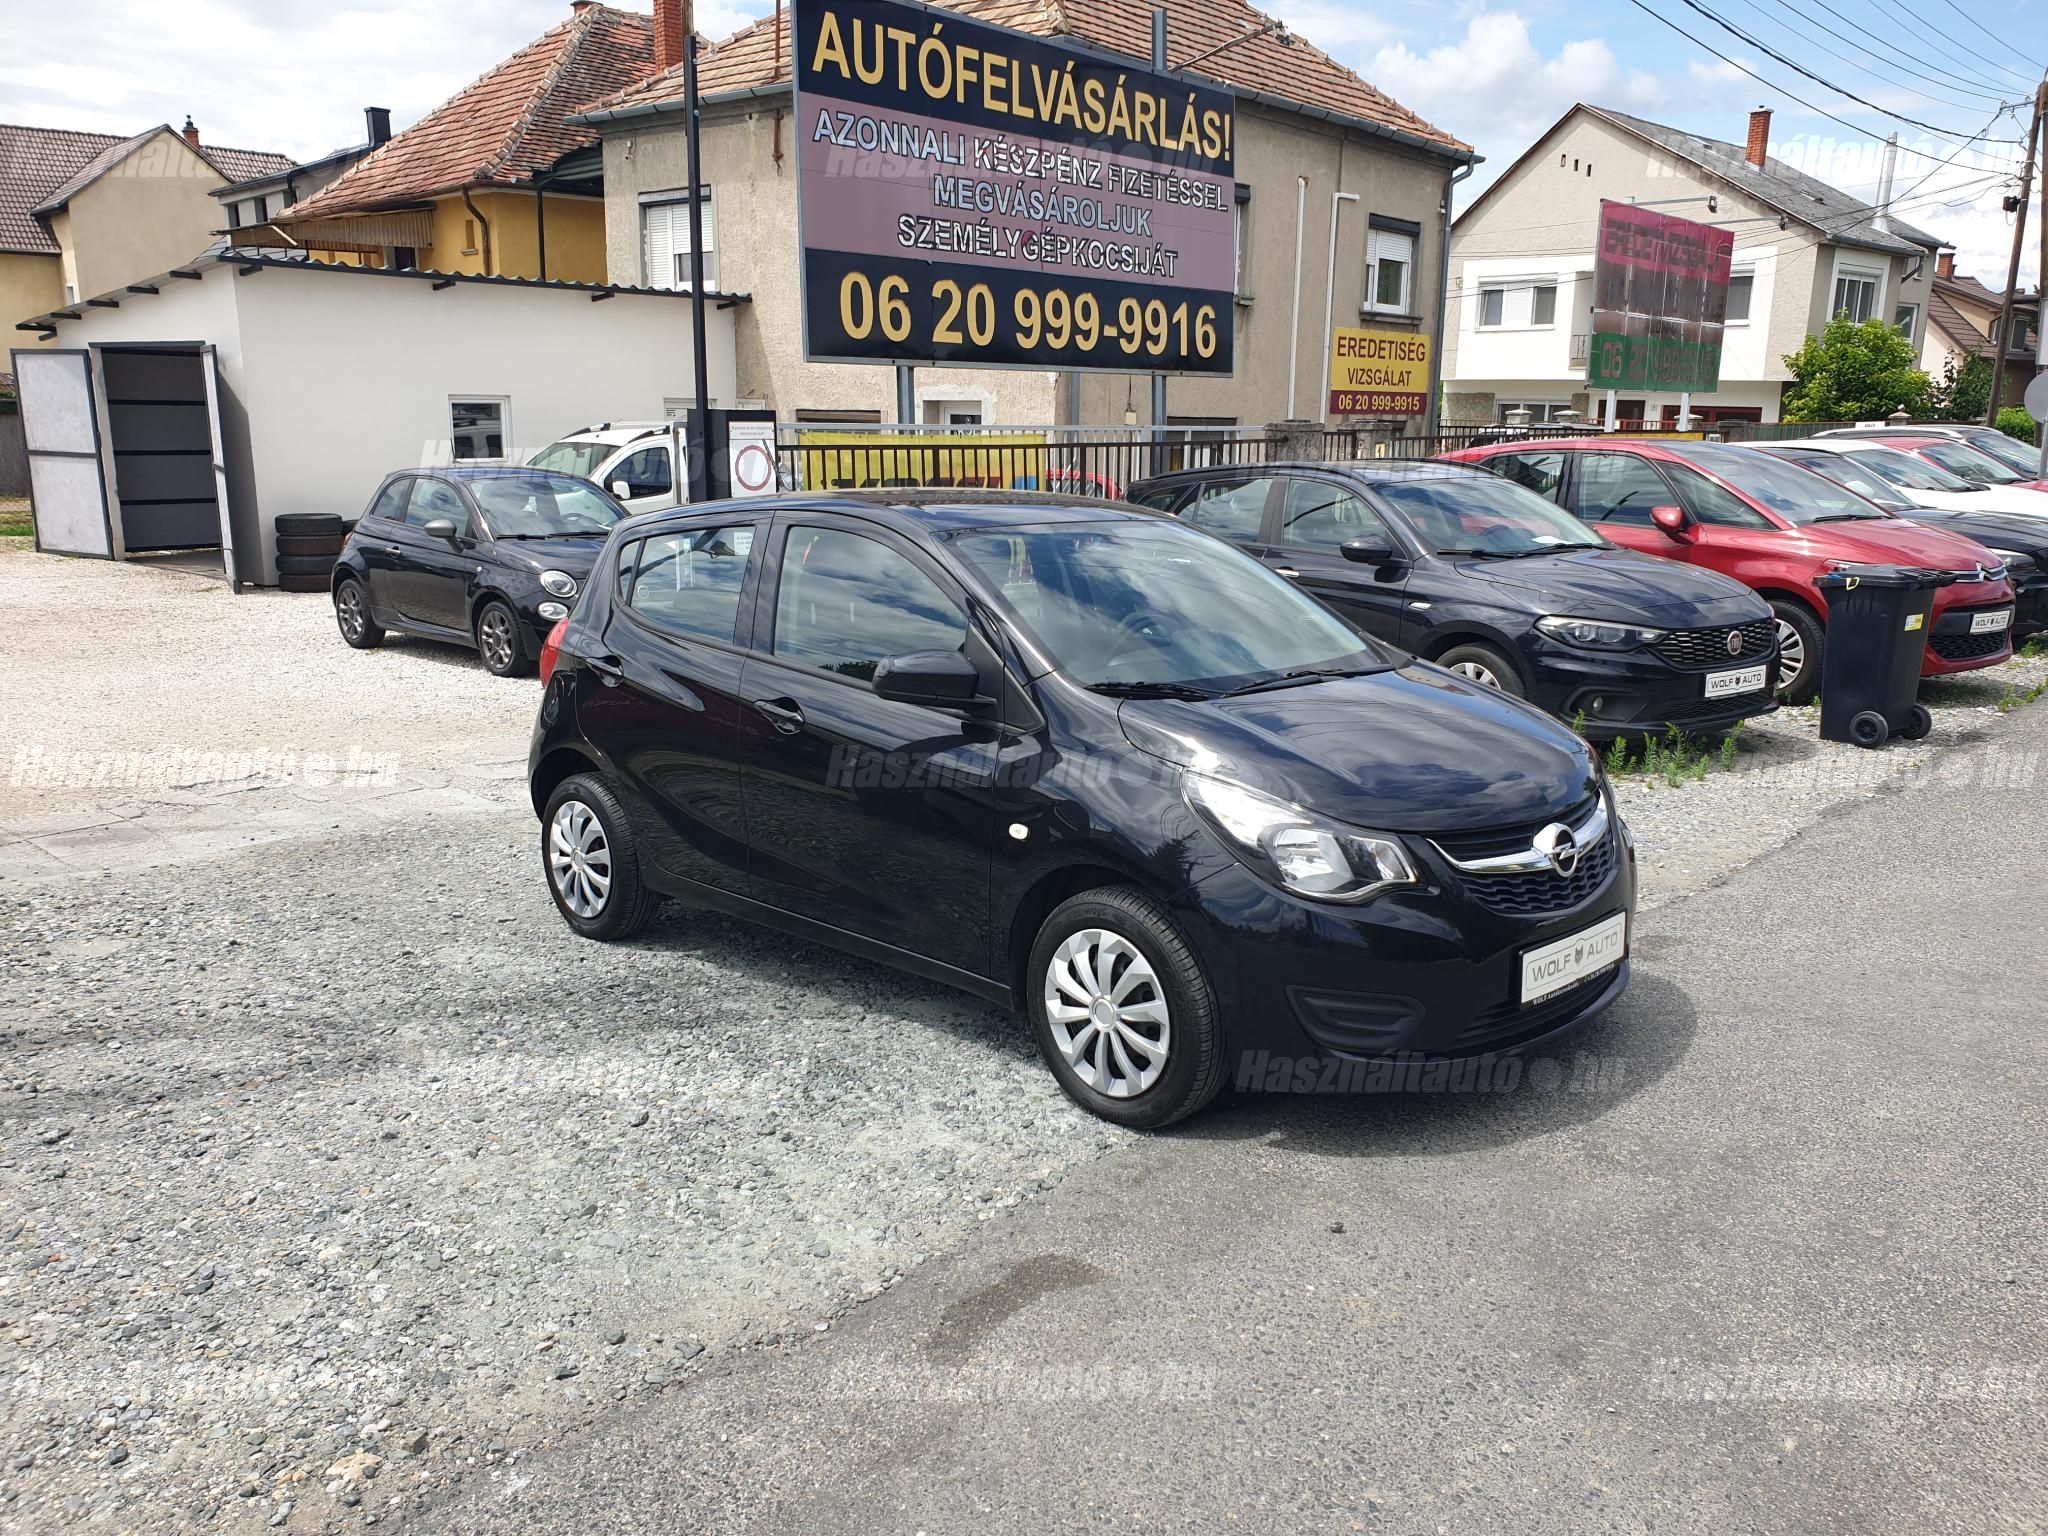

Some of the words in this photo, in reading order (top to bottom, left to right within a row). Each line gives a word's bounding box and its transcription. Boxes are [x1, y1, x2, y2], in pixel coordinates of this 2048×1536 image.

[812, 11, 1231, 161] AUTÓFELVÁSÁRLÁS!
[813, 109, 966, 165] AZONNALI
[973, 135, 1102, 190] KÉSZPÉNZ
[1107, 164, 1229, 212] FIZETÉSSEL
[933, 174, 1153, 237] MEGVÁSÁROLJUK
[897, 214, 1179, 278] SZEMÉLYGÉPKOCSIJÁT
[840, 271, 911, 342] 06
[931, 279, 996, 346] 20
[1013, 287, 1217, 359] 999-9916
[1337, 336, 1426, 362] EREDETISÉG
[1347, 365, 1412, 387] VIZSGÁLAT
[1338, 394, 1353, 410] 06
[1355, 394, 1369, 410] 20
[1371, 395, 1420, 411] 999-9915
[1711, 678, 1734, 689] WOLF
[1742, 673, 1762, 685] AUTO
[1532, 953, 1573, 983] WOLF
[1586, 931, 1618, 959] AUTO
